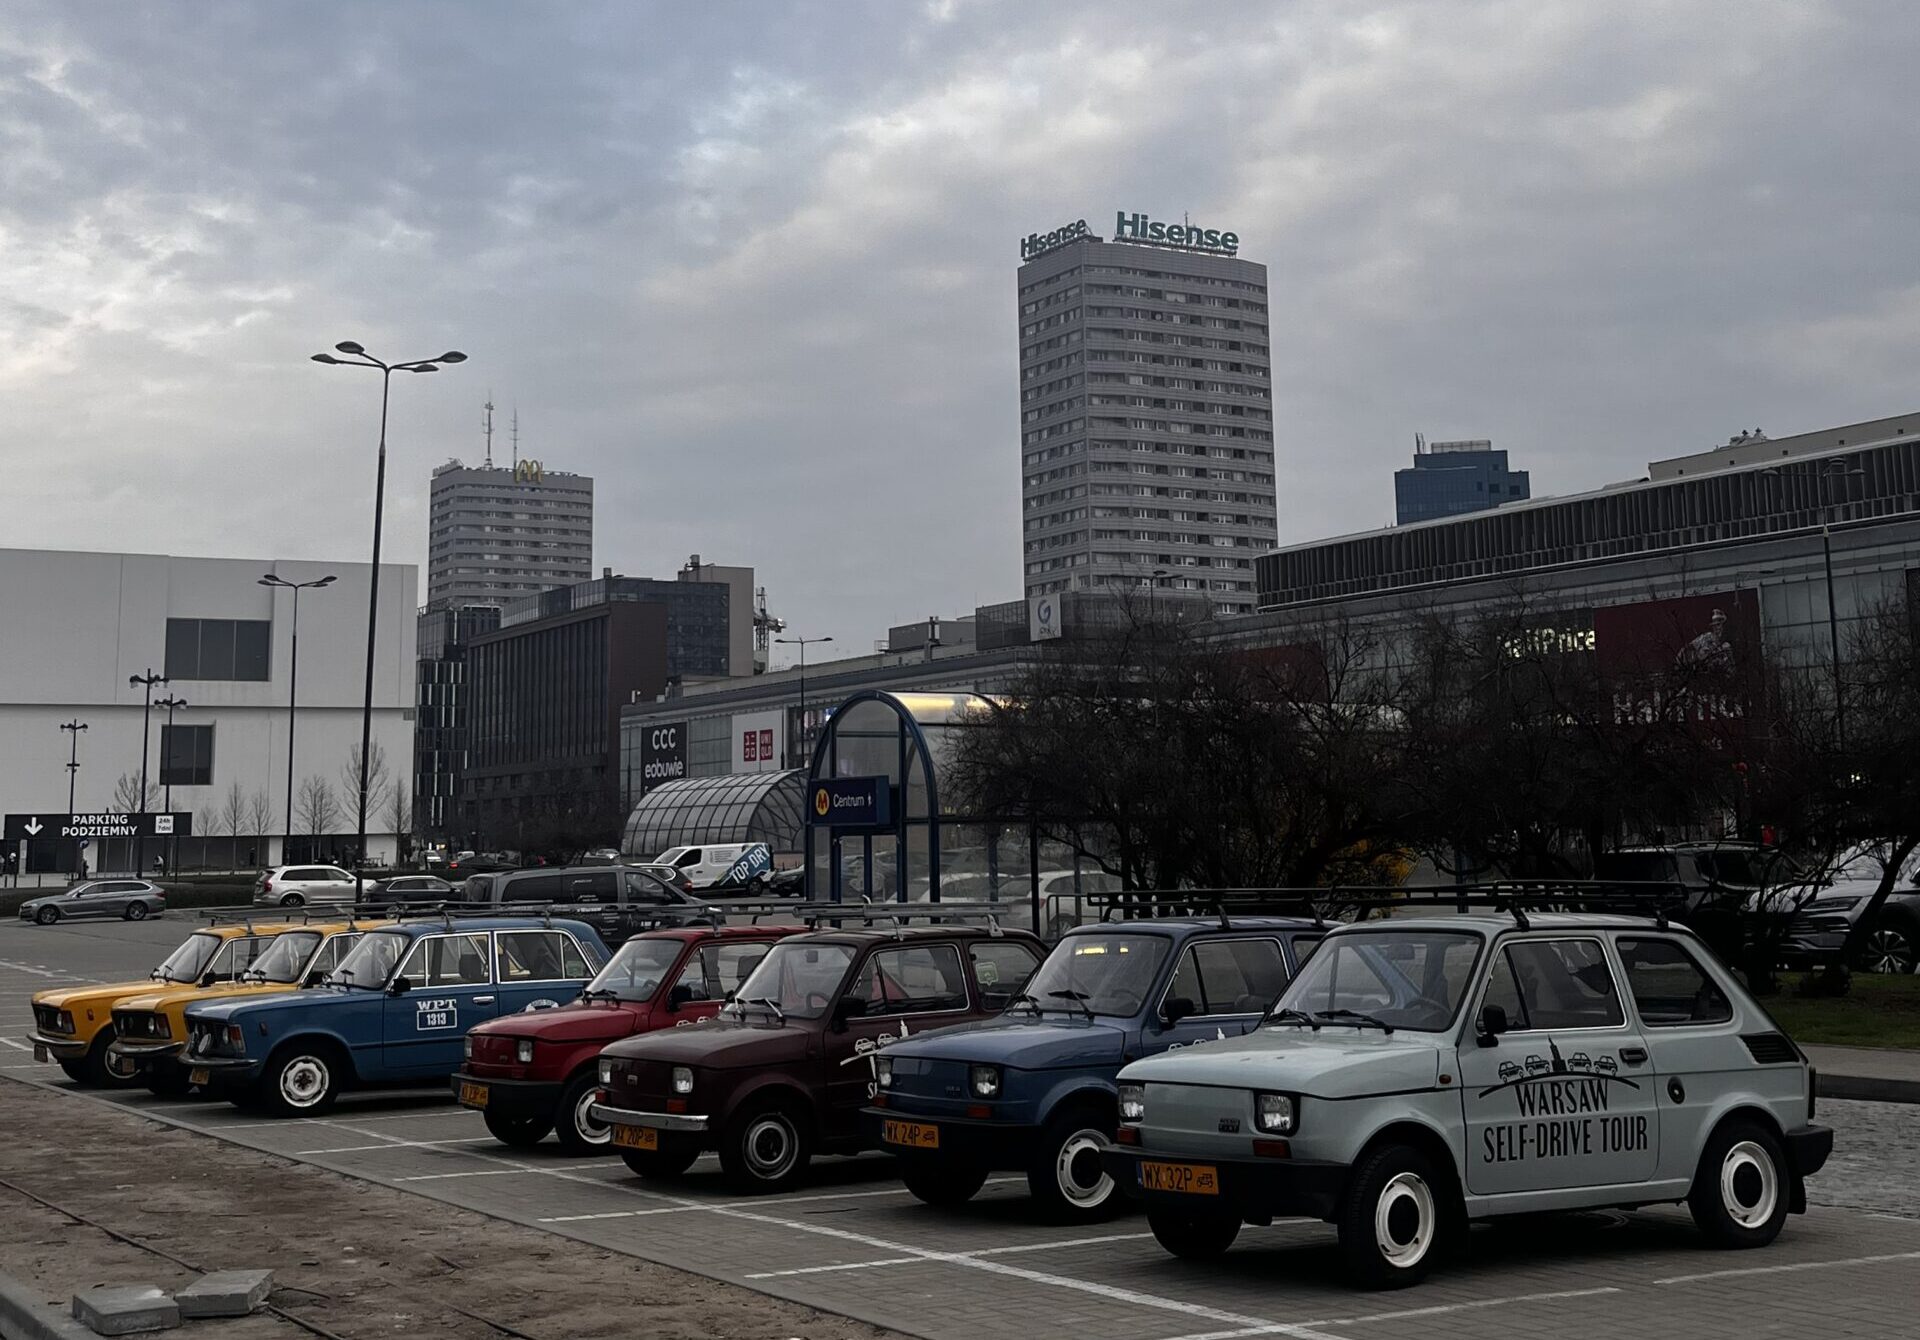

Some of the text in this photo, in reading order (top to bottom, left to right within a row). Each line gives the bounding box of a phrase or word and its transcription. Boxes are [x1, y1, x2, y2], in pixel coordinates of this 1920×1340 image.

[1021, 218, 1087, 258] Hisense
[1116, 210, 1239, 251] Hisense
[652, 728, 677, 750] CCC
[644, 755, 684, 779] eobuwie
[833, 793, 865, 808] Centrum
[61, 825, 138, 837] PODZIEMNY
[72, 814, 128, 826] PARKING
[730, 860, 750, 885] TOP
[748, 843, 770, 868] DRY
[416, 998, 457, 1011] WPT
[426, 1012, 447, 1026] 1313
[1514, 1079, 1608, 1117] WARSAW
[901, 1124, 921, 1146] 24P
[1483, 1115, 1648, 1163] SELF-DRIVE TOUR
[1144, 1163, 1193, 1191] WX 32P
